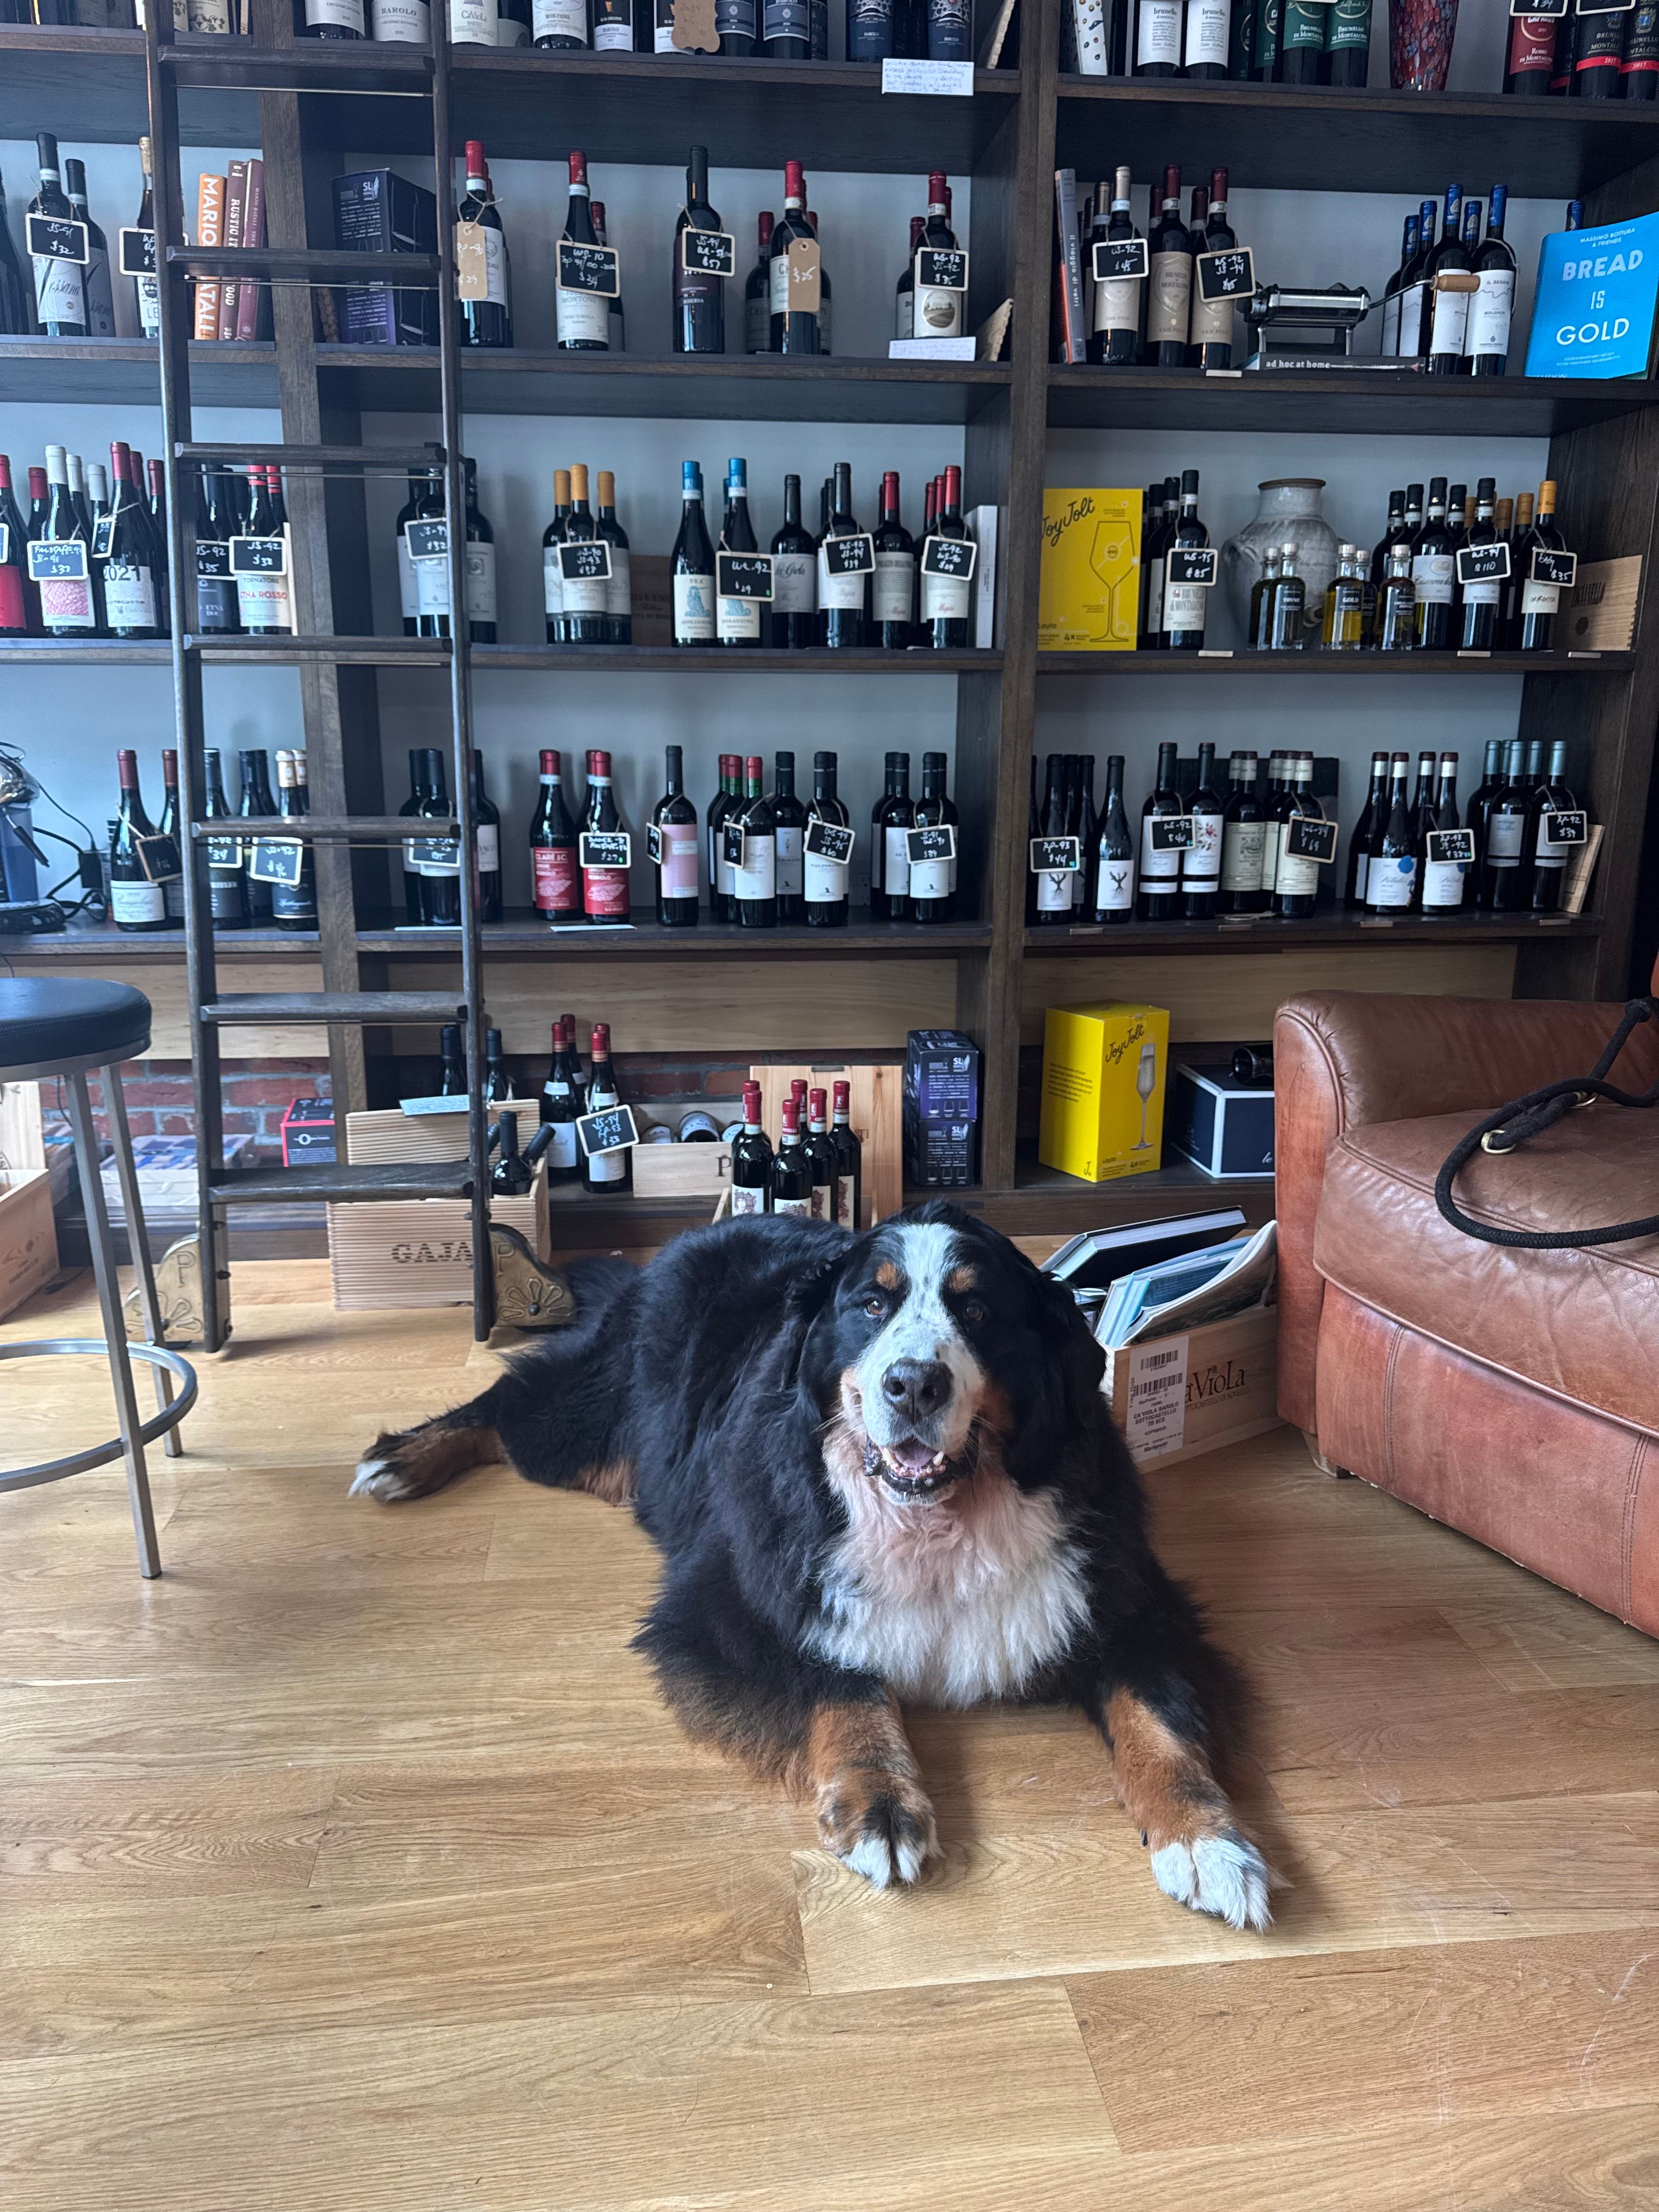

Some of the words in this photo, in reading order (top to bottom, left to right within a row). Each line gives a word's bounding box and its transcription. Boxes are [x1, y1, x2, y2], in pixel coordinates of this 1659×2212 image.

[381, 7, 416, 16] BAROLO
[202, 177, 218, 247] MARIO
[230, 198, 240, 236] RUSTIC
[1580, 233, 1609, 243] MASSIMO
[1610, 227, 1635, 239] BOTTURA
[1598, 236, 1622, 247] FRIENDS
[1562, 250, 1644, 281] BREAD
[198, 276, 217, 331] ATALI
[1590, 290, 1606, 310] IS
[1556, 318, 1630, 346] GOLD
[1266, 359, 1277, 368] ad
[1279, 359, 1294, 368] hoc
[1306, 360, 1330, 369] home
[258, 590, 288, 600] ROSSO
[1105, 1024, 1144, 1065] JoyJolt
[391, 1241, 474, 1263] GAJA
[1135, 1407, 1177, 1425] SOTTOCASTELLO
[1158, 1401, 1180, 1412] BAROLO
